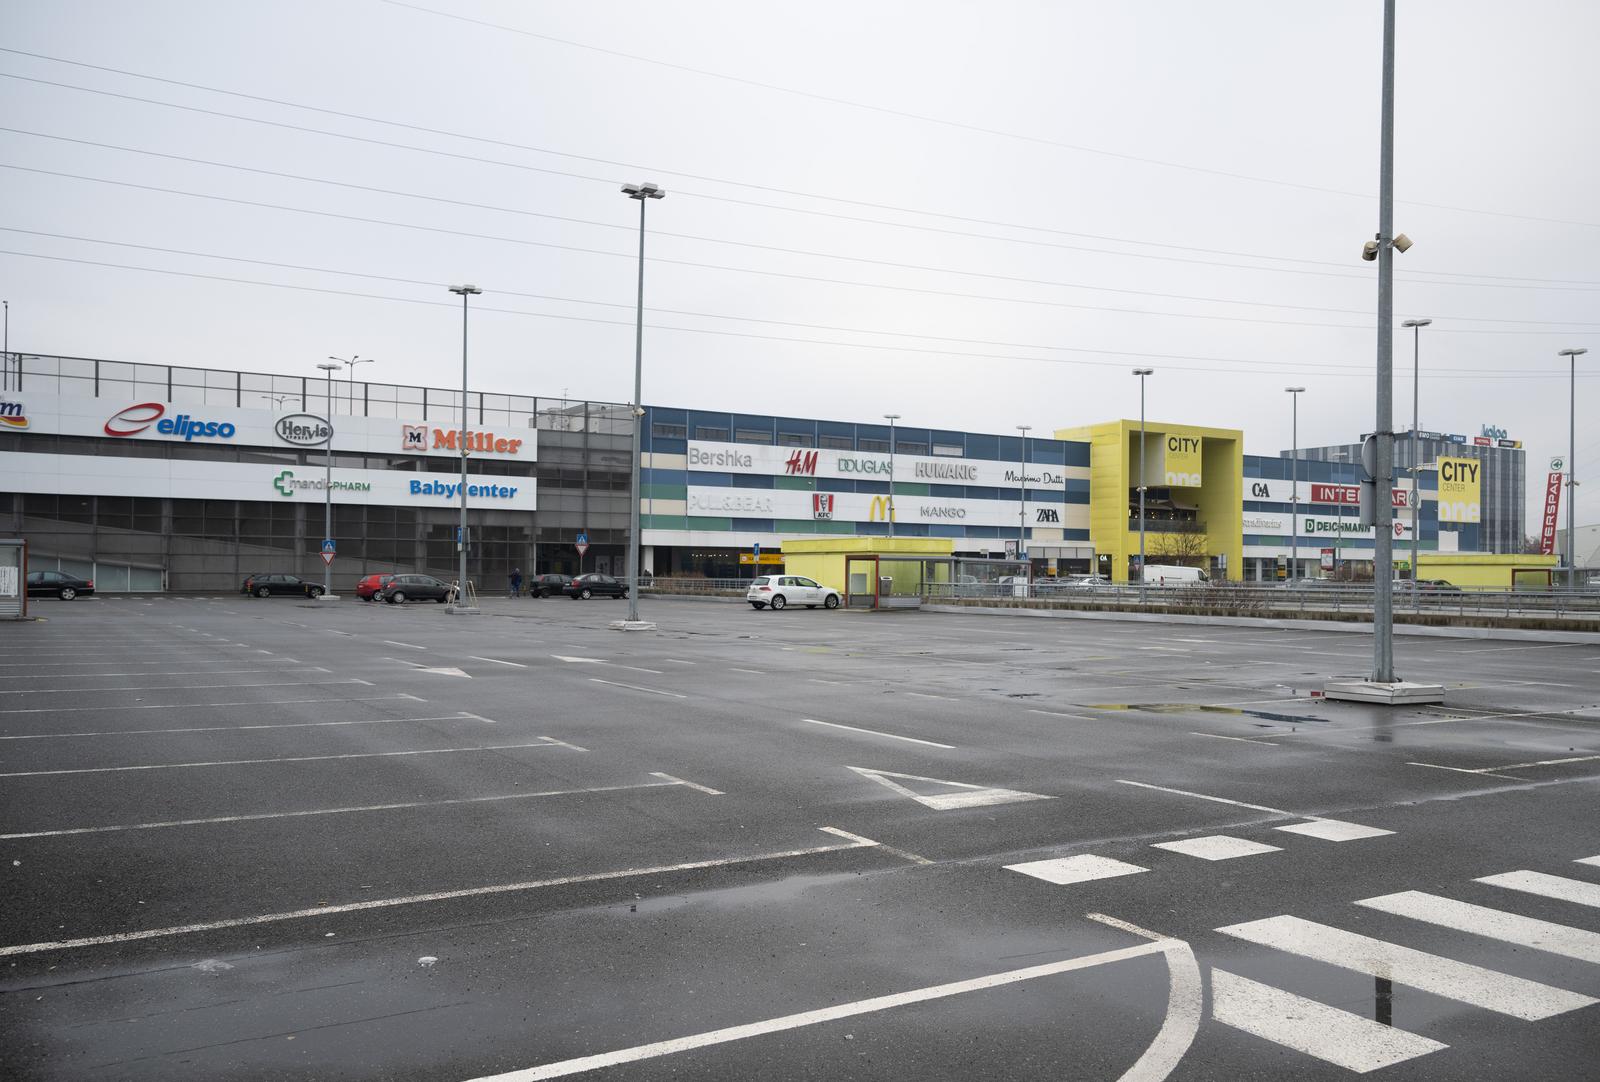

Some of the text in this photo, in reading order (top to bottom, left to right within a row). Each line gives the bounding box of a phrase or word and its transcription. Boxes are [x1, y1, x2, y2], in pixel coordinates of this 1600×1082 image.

[156, 414, 236, 441] elipso
[282, 420, 328, 440] Hervis
[432, 428, 522, 454] Müller
[1168, 437, 1199, 453] CITY
[689, 447, 752, 468] Bershka
[785, 450, 818, 475] H&M
[838, 458, 893, 475] DOUGLAS
[915, 461, 977, 480] HUMANIC
[1004, 470, 1064, 484] Massimo Dutti
[1166, 471, 1201, 487] one
[1442, 461, 1478, 483] CITY
[1442, 483, 1465, 492] CENTER
[920, 505, 966, 519] MANGO
[1036, 508, 1060, 523] ZARA
[1440, 501, 1480, 520] one
[1316, 520, 1371, 533] DEICHMANN
